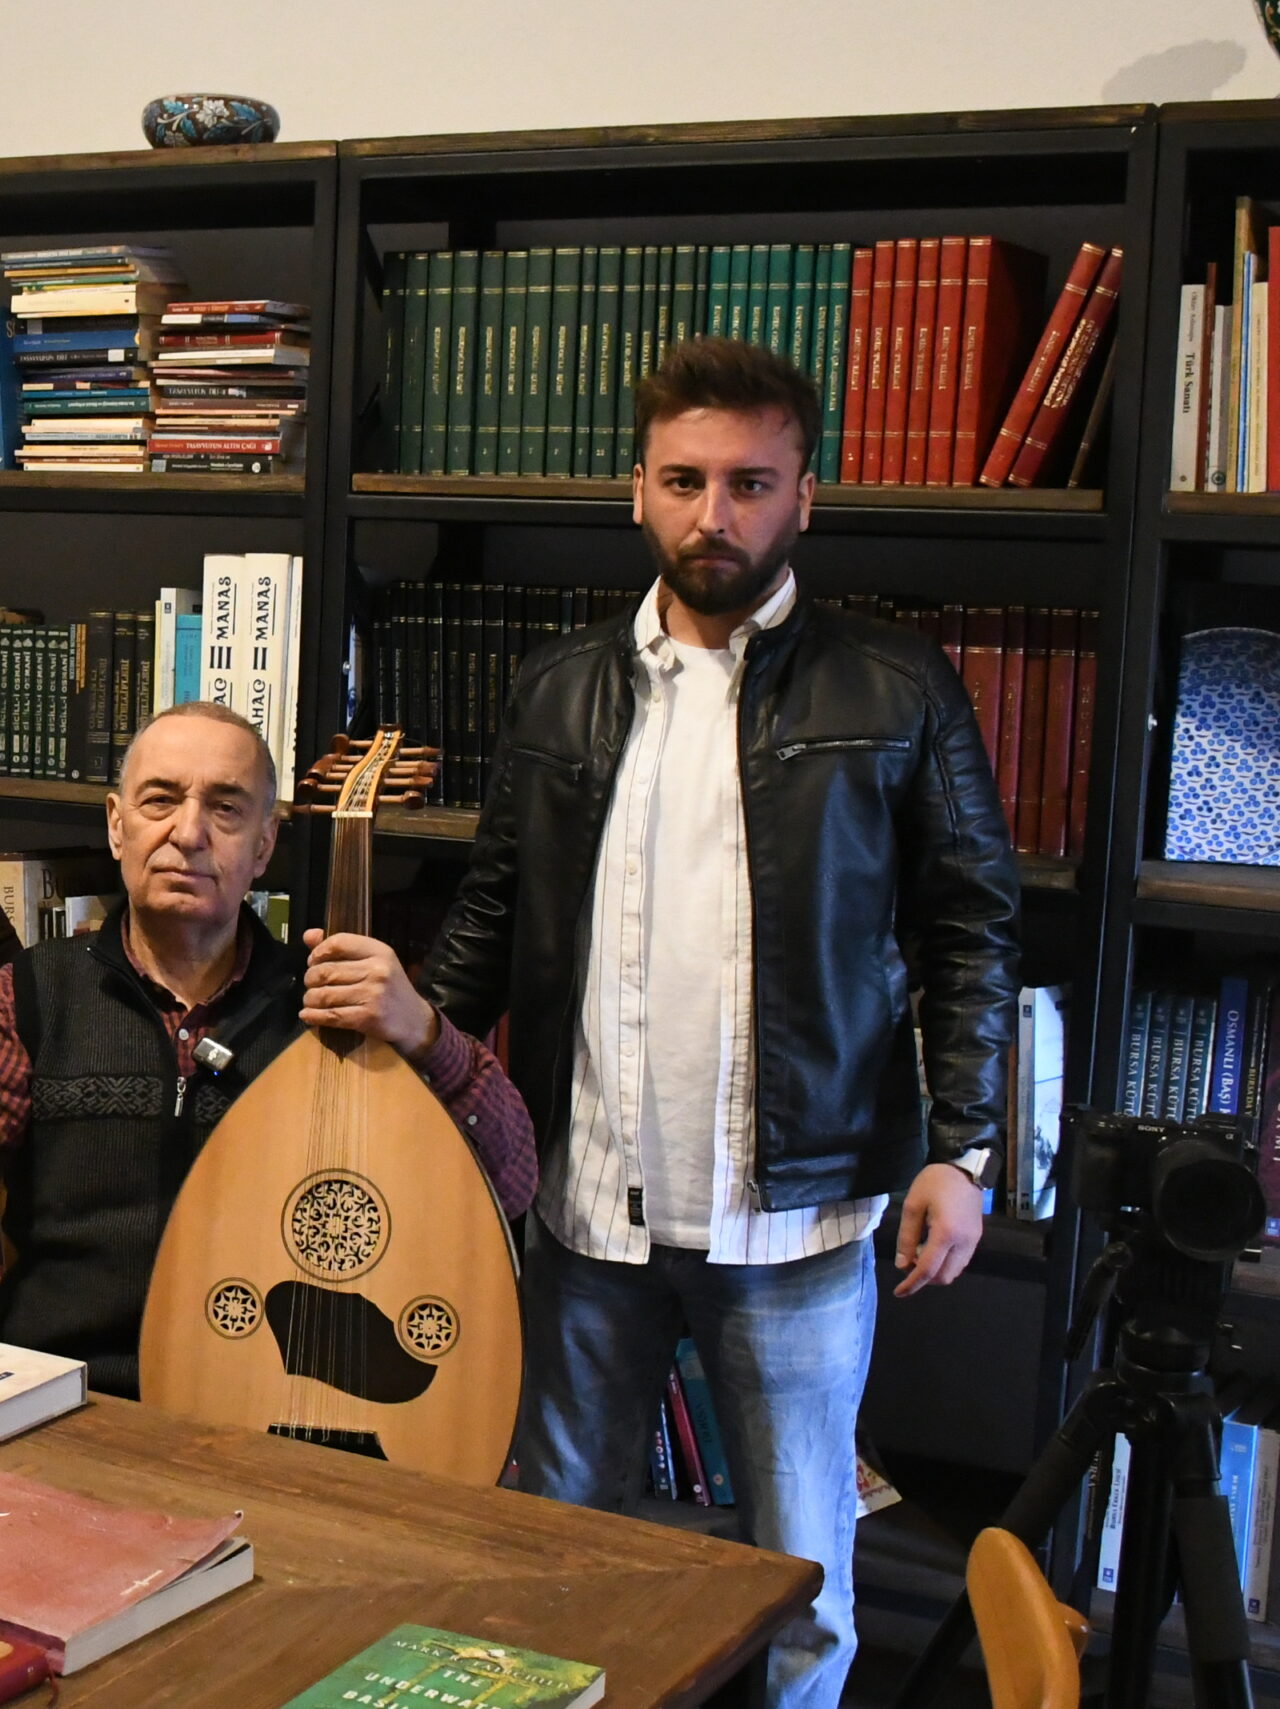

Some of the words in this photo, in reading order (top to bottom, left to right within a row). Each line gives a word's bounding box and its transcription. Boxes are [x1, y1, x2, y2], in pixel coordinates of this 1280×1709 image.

[1184, 353, 1196, 378] Türk
[1182, 381, 1193, 414] Sanatı
[215, 576, 232, 640] MANAS
[255, 576, 271, 640] MANAS
[252, 679, 266, 741] АНАС
[3, 886, 15, 927] BURS
[1127, 1034, 1141, 1075] BURSA
[1148, 1036, 1162, 1078] BURSA
[1223, 1010, 1239, 1068] OSMANLI
[1170, 1039, 1184, 1081] BURSA
[1190, 1040, 1204, 1082] BURSA
[1123, 1081, 1137, 1116] KÜTÜ
[1145, 1083, 1158, 1118] KÜTÜ
[1167, 1085, 1180, 1120] KÜTÜ
[1217, 1072, 1233, 1104] (BAŞ)
[1138, 1124, 1165, 1133] SONY
[393, 1640, 441, 1657] MARK
[473, 1660, 570, 1690] FAIRCHILD
[442, 1669, 486, 1687] THE
[364, 1672, 504, 1709] UNDERWAT
